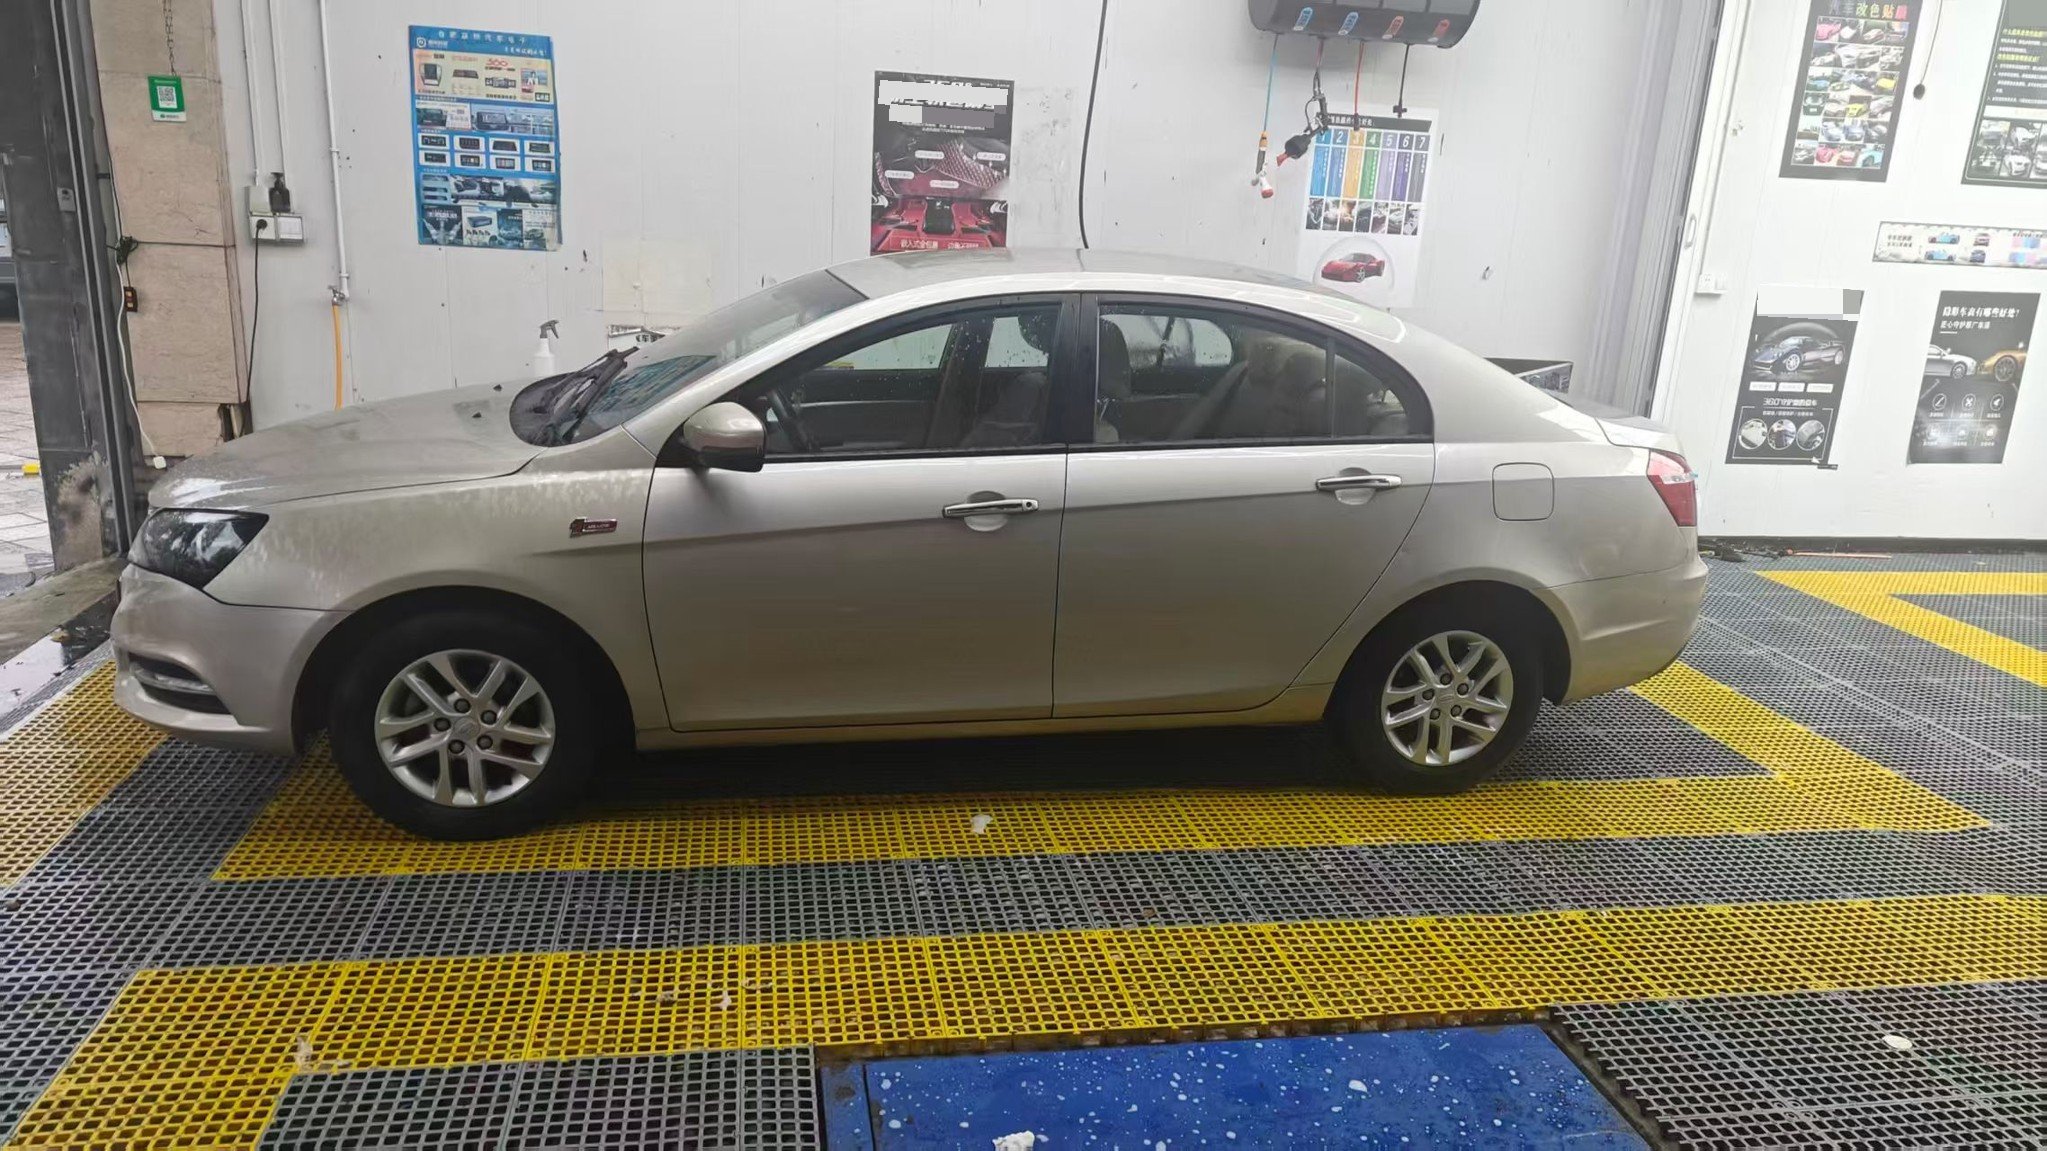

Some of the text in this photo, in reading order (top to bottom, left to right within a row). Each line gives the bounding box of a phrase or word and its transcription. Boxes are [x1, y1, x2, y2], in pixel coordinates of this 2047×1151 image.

[1336, 131, 1344, 143] 2
[1353, 132, 1361, 144] 3
[1369, 133, 1377, 145] 4
[1386, 134, 1394, 146] 5
[1402, 135, 1411, 148] 6
[1418, 136, 1427, 149] 7
